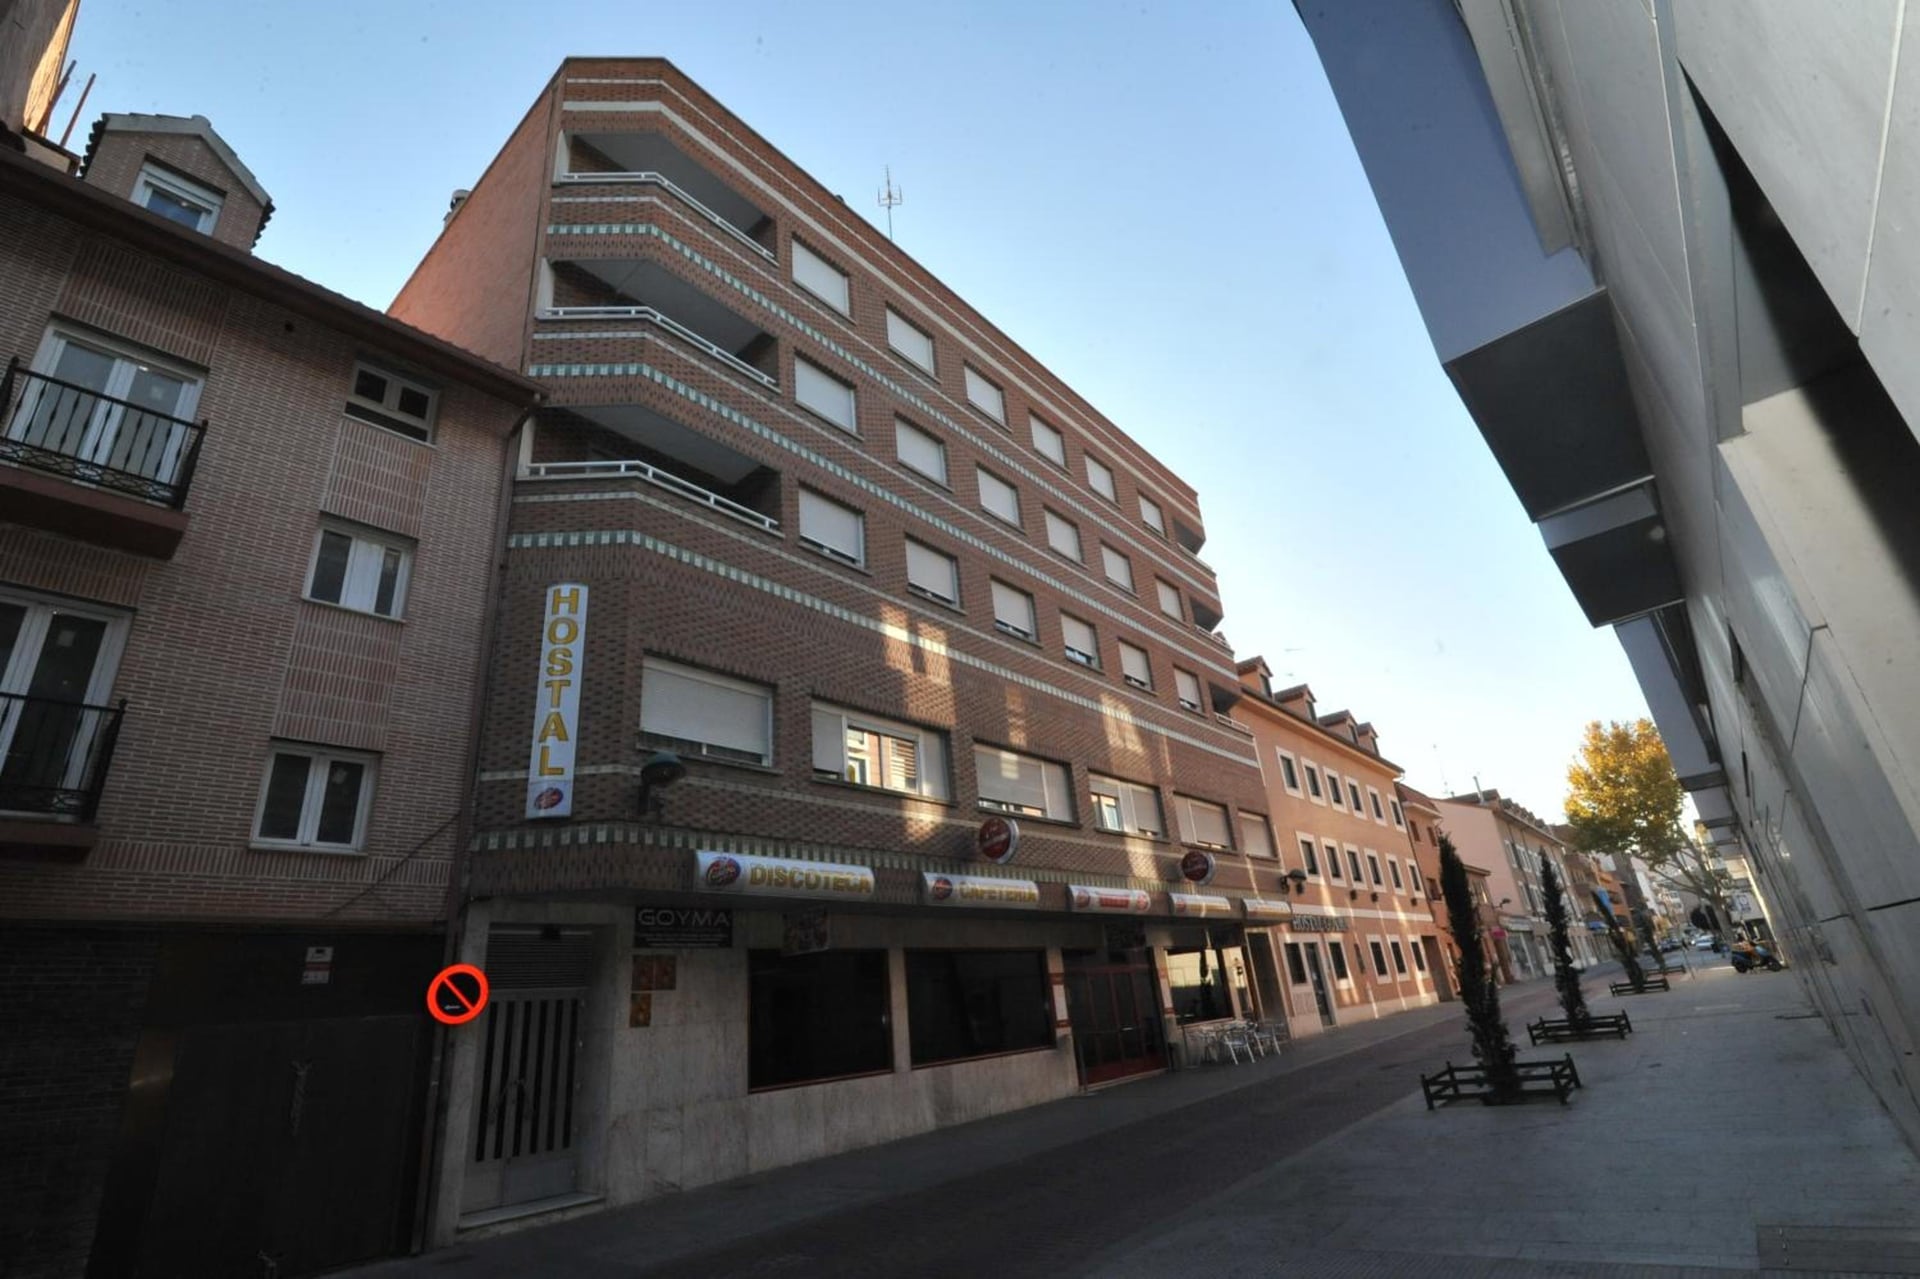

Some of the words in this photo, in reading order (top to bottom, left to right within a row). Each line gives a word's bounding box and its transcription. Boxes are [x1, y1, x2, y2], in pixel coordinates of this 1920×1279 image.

[539, 588, 579, 776] HOSTAL
[749, 862, 873, 894] DISCOTECA
[638, 908, 730, 927] GOYMA
